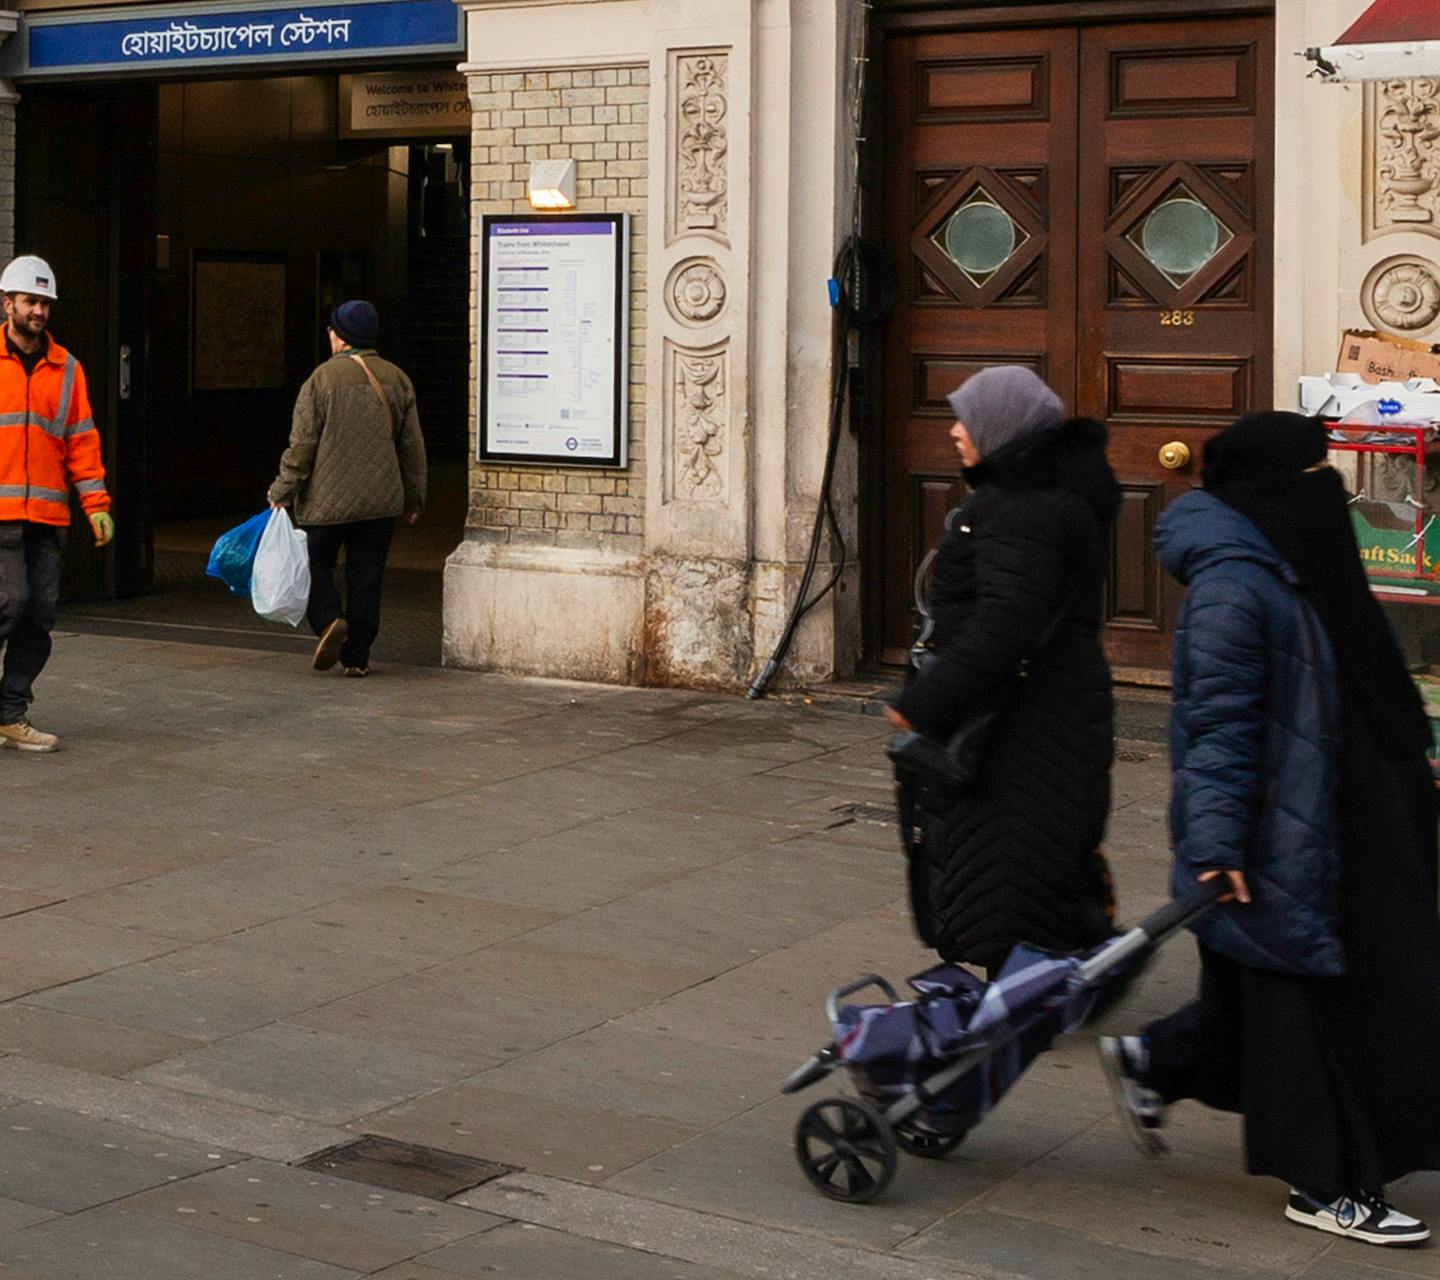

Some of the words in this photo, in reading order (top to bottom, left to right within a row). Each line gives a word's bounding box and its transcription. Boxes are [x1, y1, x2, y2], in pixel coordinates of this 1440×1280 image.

[121, 25, 273, 57] হোয়াইটচ্যাপেল
[280, 18, 350, 46] স্টেশন
[366, 84, 415, 95] Welcome
[419, 83, 429, 93] to
